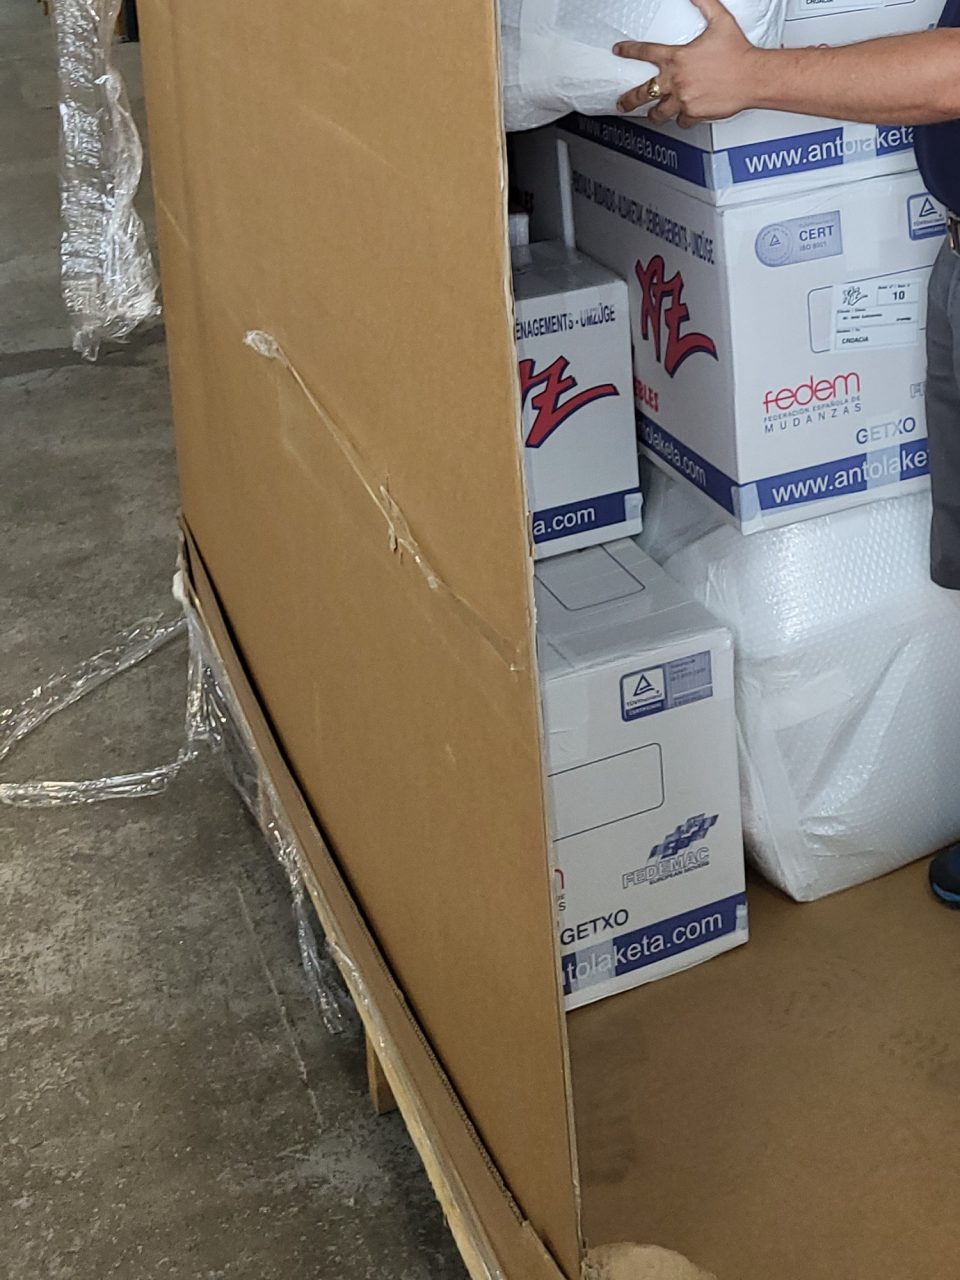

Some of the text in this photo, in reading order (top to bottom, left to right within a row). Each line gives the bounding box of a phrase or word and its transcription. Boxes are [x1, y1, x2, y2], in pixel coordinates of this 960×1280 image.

[799, 224, 834, 242] CERT
[892, 290, 905, 301] 10
[763, 371, 860, 414] fedem
[764, 402, 862, 433] MUDANZAS
[855, 417, 916, 445] GETXO
[772, 449, 929, 504] www.antolake
[560, 908, 629, 946] GETXO
